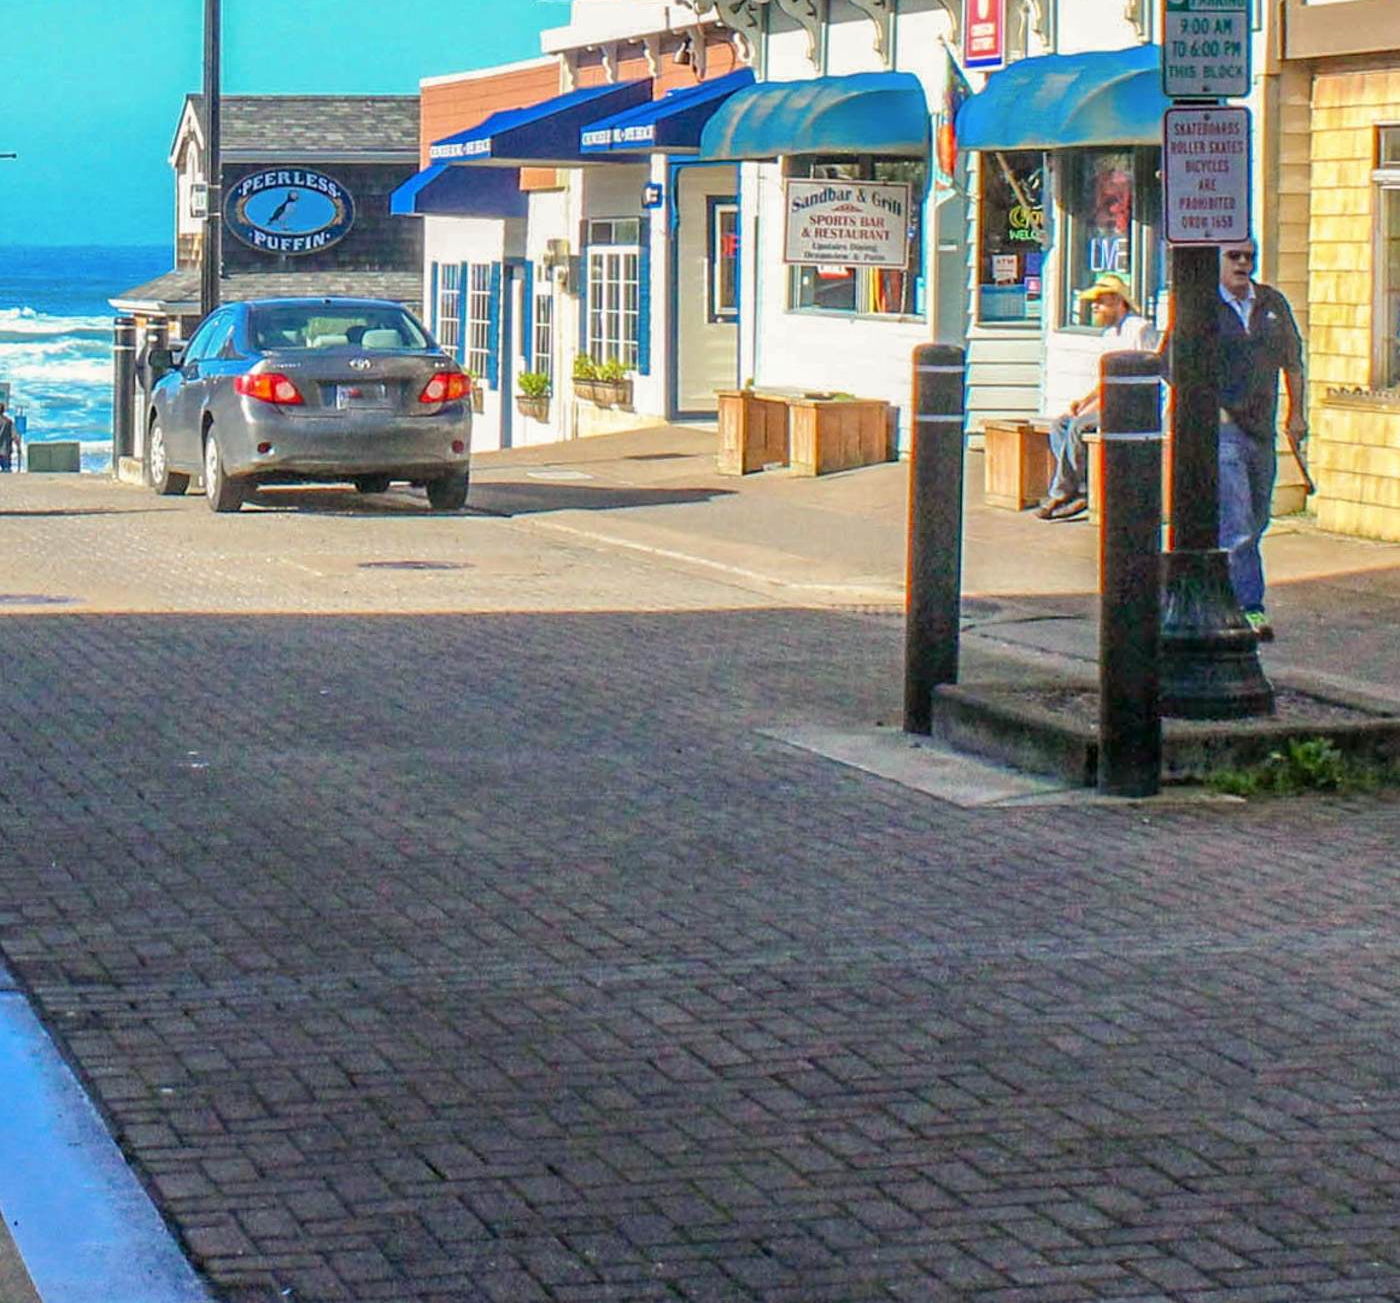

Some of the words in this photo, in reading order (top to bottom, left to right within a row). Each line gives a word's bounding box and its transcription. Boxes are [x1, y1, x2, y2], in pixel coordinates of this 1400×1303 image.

[1214, 18, 1233, 35] AM
[1172, 40, 1186, 58] TO
[1224, 41, 1242, 57] PM
[1168, 64, 1196, 79] THIS
[1203, 64, 1243, 79] BLOCK
[1174, 121, 1240, 136] SKATEBOARDS
[1171, 141, 1206, 156] ROLLER
[1210, 141, 1244, 156] SKATES
[1185, 159, 1229, 174] BICYCLES
[242, 171, 337, 198] PEERLESS
[1198, 178, 1217, 192] ARE
[791, 186, 853, 213] Sandbar
[856, 187, 867, 203] &
[872, 190, 902, 217] Grill
[1179, 196, 1236, 211] PROHIBITED
[809, 214, 856, 228] SPORTS
[861, 216, 885, 229] BAR
[253, 229, 325, 251] PUFFIN
[801, 227, 811, 239] &
[815, 228, 890, 241] RESTAURANT
[1090, 237, 1129, 273] LIVE
